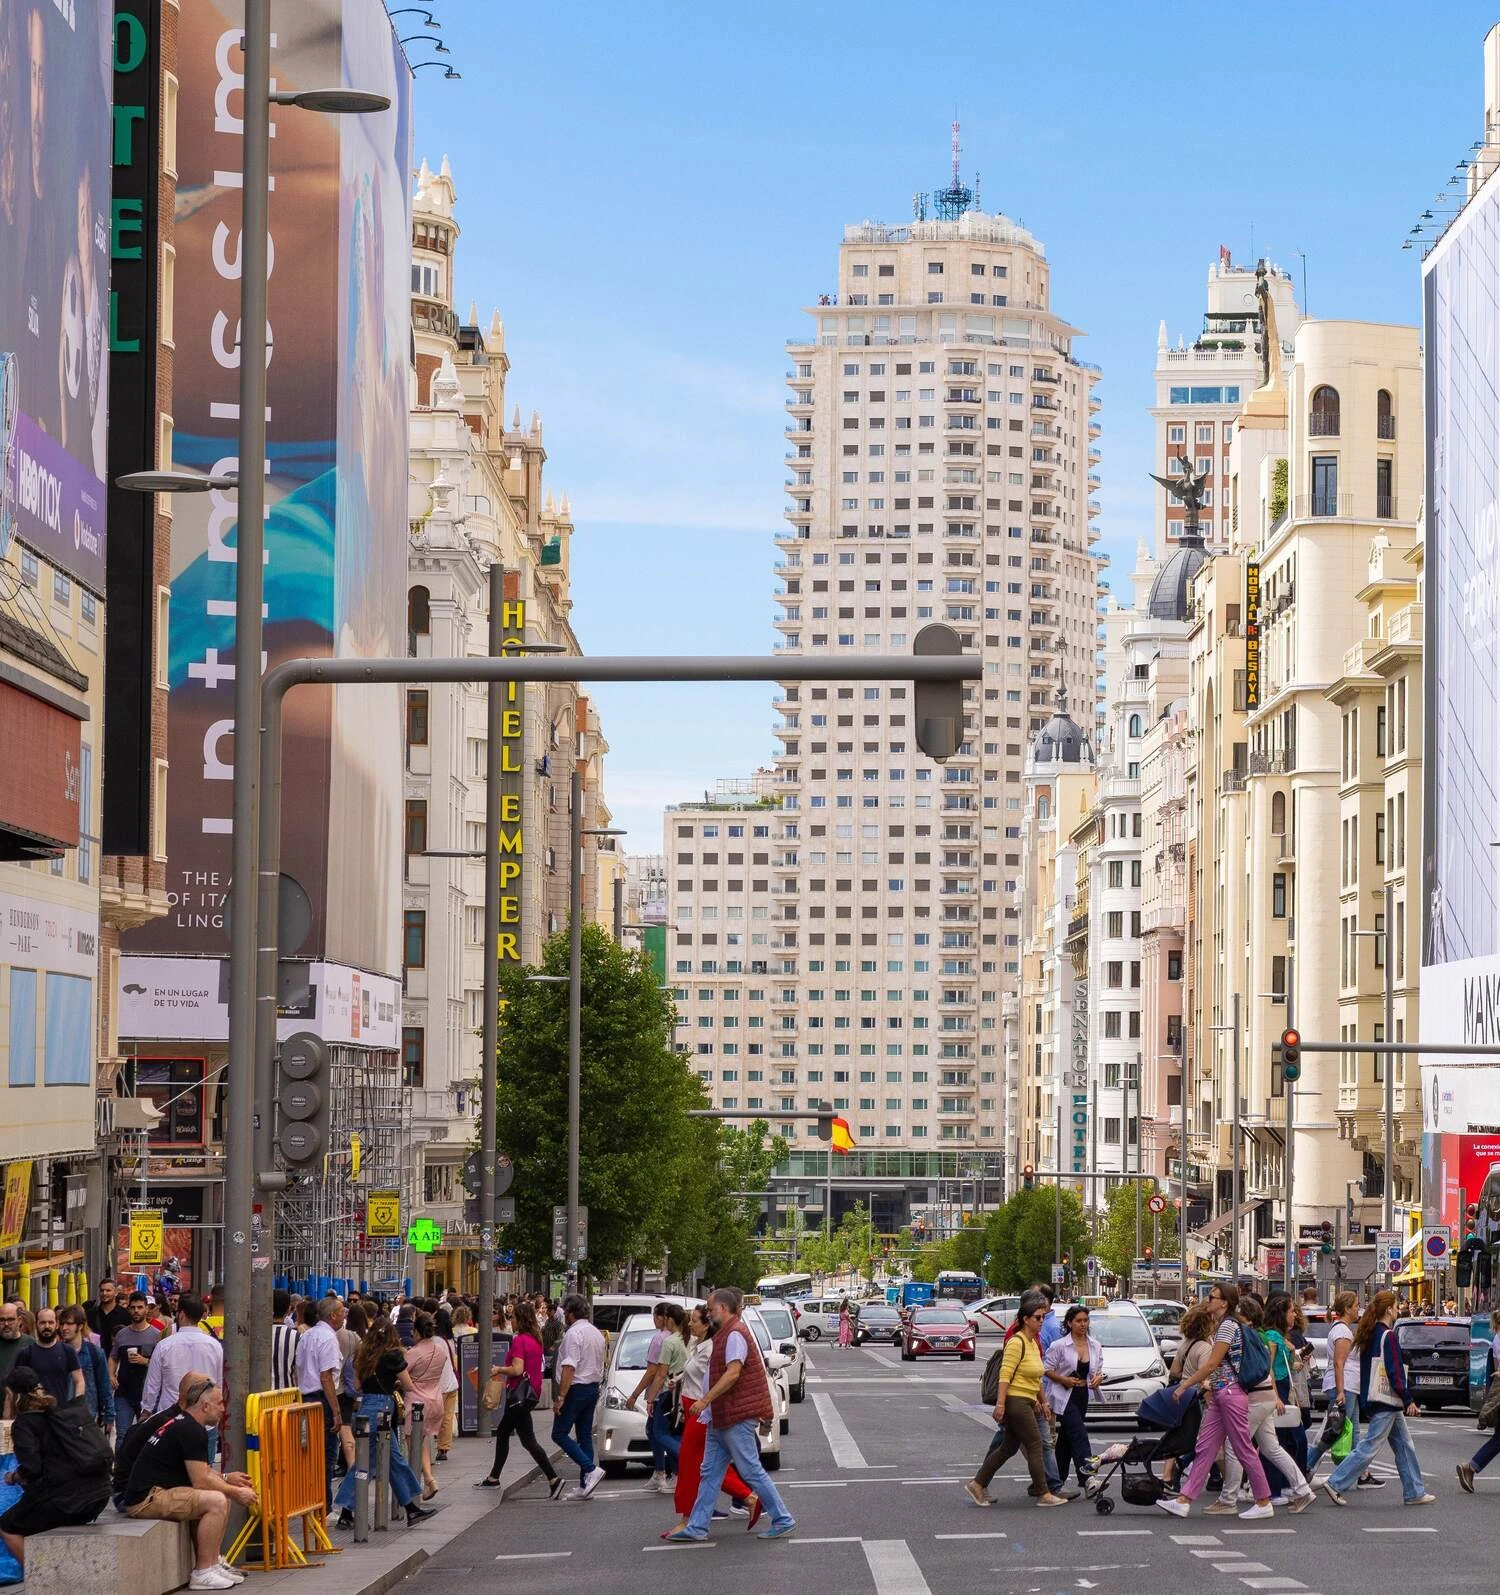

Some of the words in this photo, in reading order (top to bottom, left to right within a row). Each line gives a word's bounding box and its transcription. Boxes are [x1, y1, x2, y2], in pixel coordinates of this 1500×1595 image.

[1248, 567, 1259, 620] HOSTAL
[1247, 640, 1258, 703] BESAYA
[182, 872, 219, 885] THE
[167, 893, 191, 906] OF
[177, 914, 223, 928] LING
[154, 989, 166, 997] EN
[167, 989, 180, 997] UN
[181, 989, 209, 998] LUGAR
[180, 1000, 199, 1008] VIDA
[1073, 983, 1088, 1088] SENATOR
